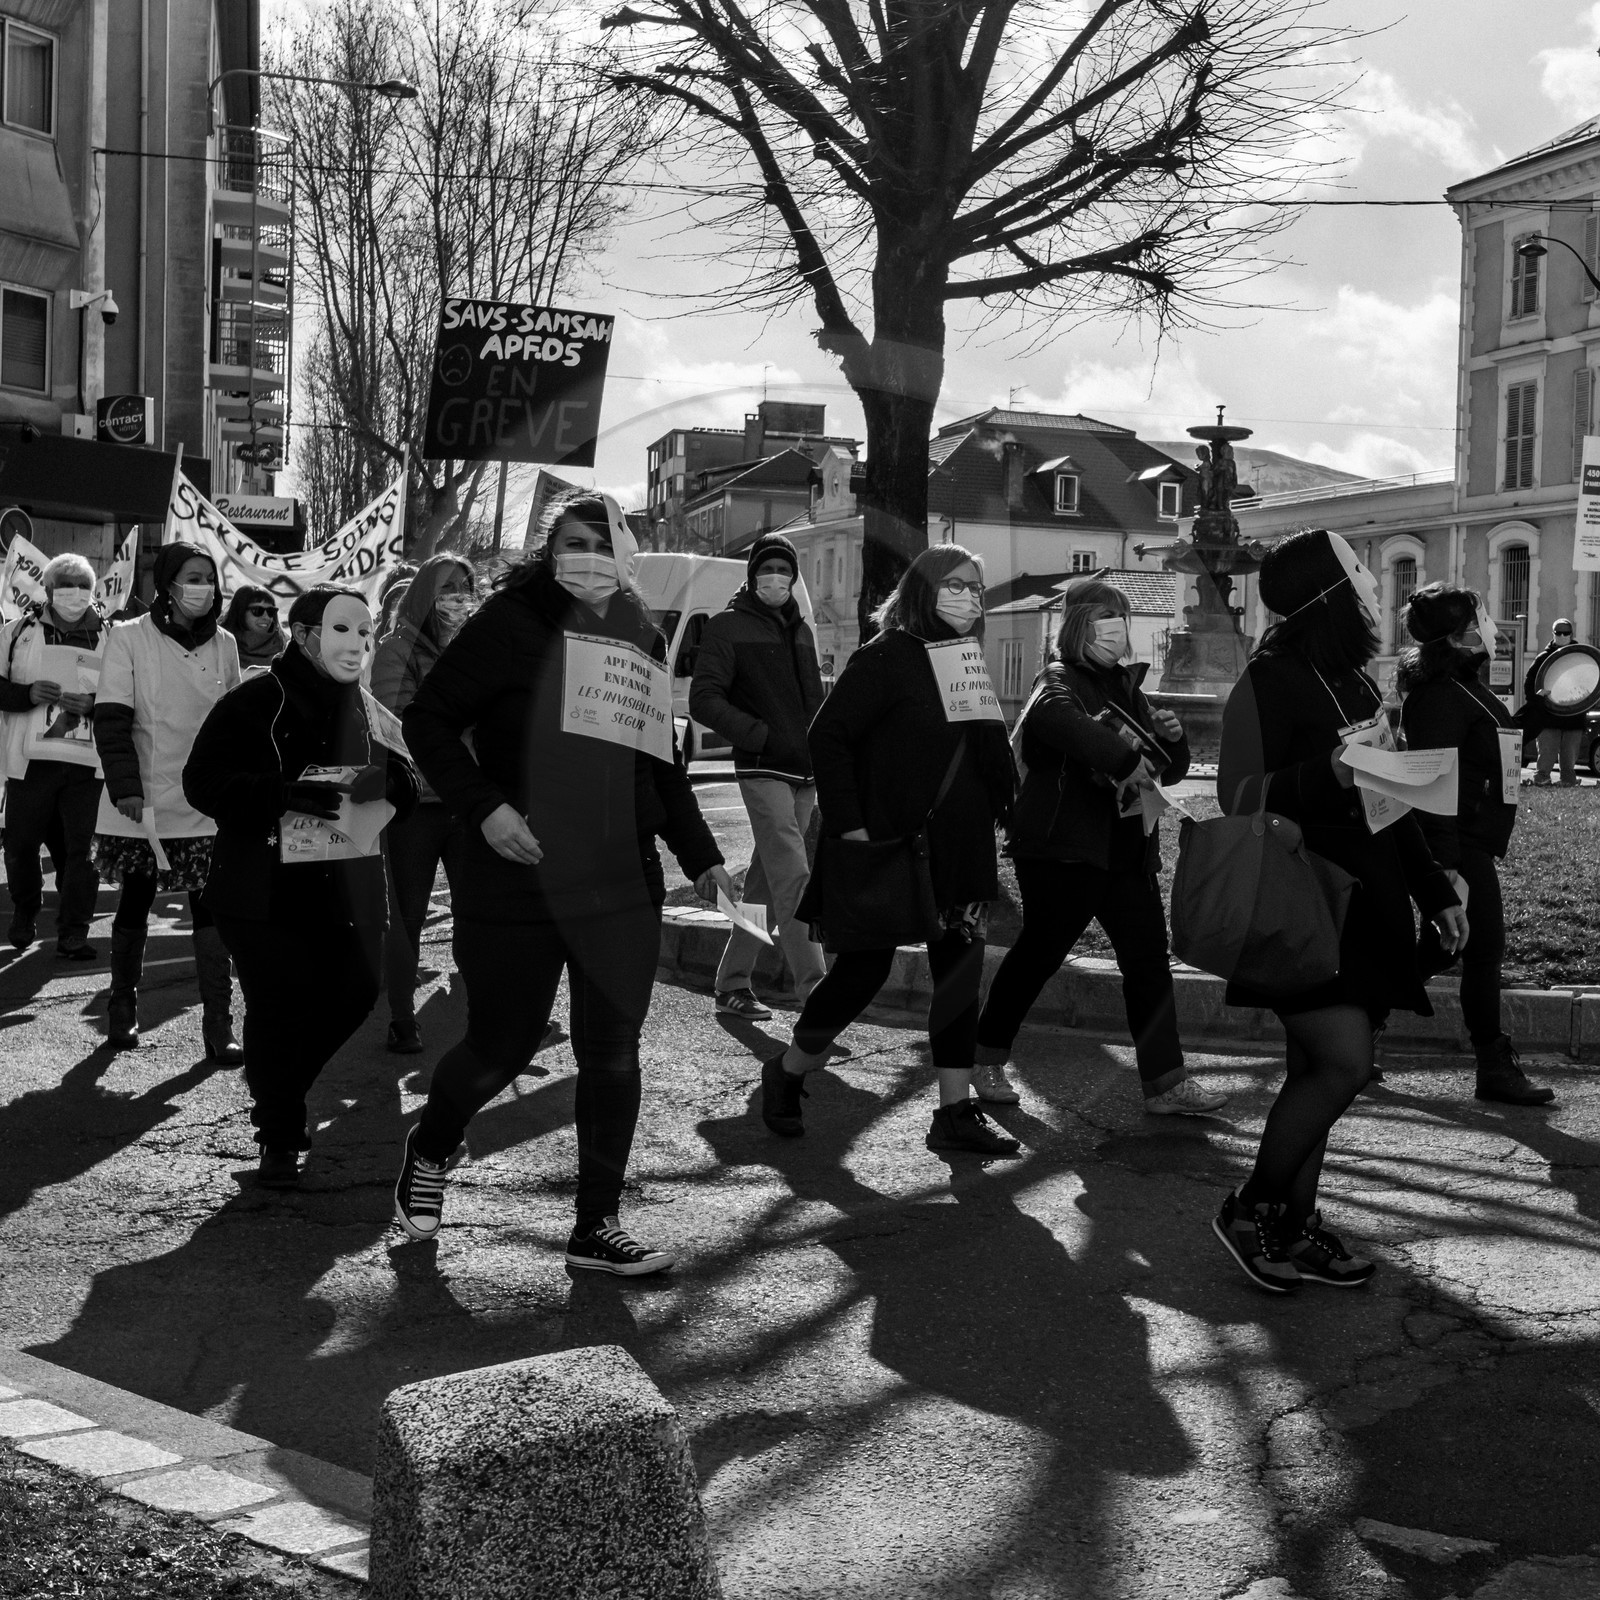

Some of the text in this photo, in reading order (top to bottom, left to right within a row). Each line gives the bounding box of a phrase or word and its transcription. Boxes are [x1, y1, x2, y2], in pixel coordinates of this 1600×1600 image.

[486, 364, 538, 397] EN
[437, 397, 589, 451] GREVE
[215, 498, 290, 521] Restaurant
[603, 655, 652, 681] APF POLE
[961, 651, 979, 661] APF
[604, 671, 652, 697] ENFANCE
[950, 681, 967, 693] LES
[577, 685, 667, 725] LES INVISIBLES DE
[583, 708, 598, 716] APF
[610, 711, 646, 732] SEGUR
[293, 817, 315, 830] LES
